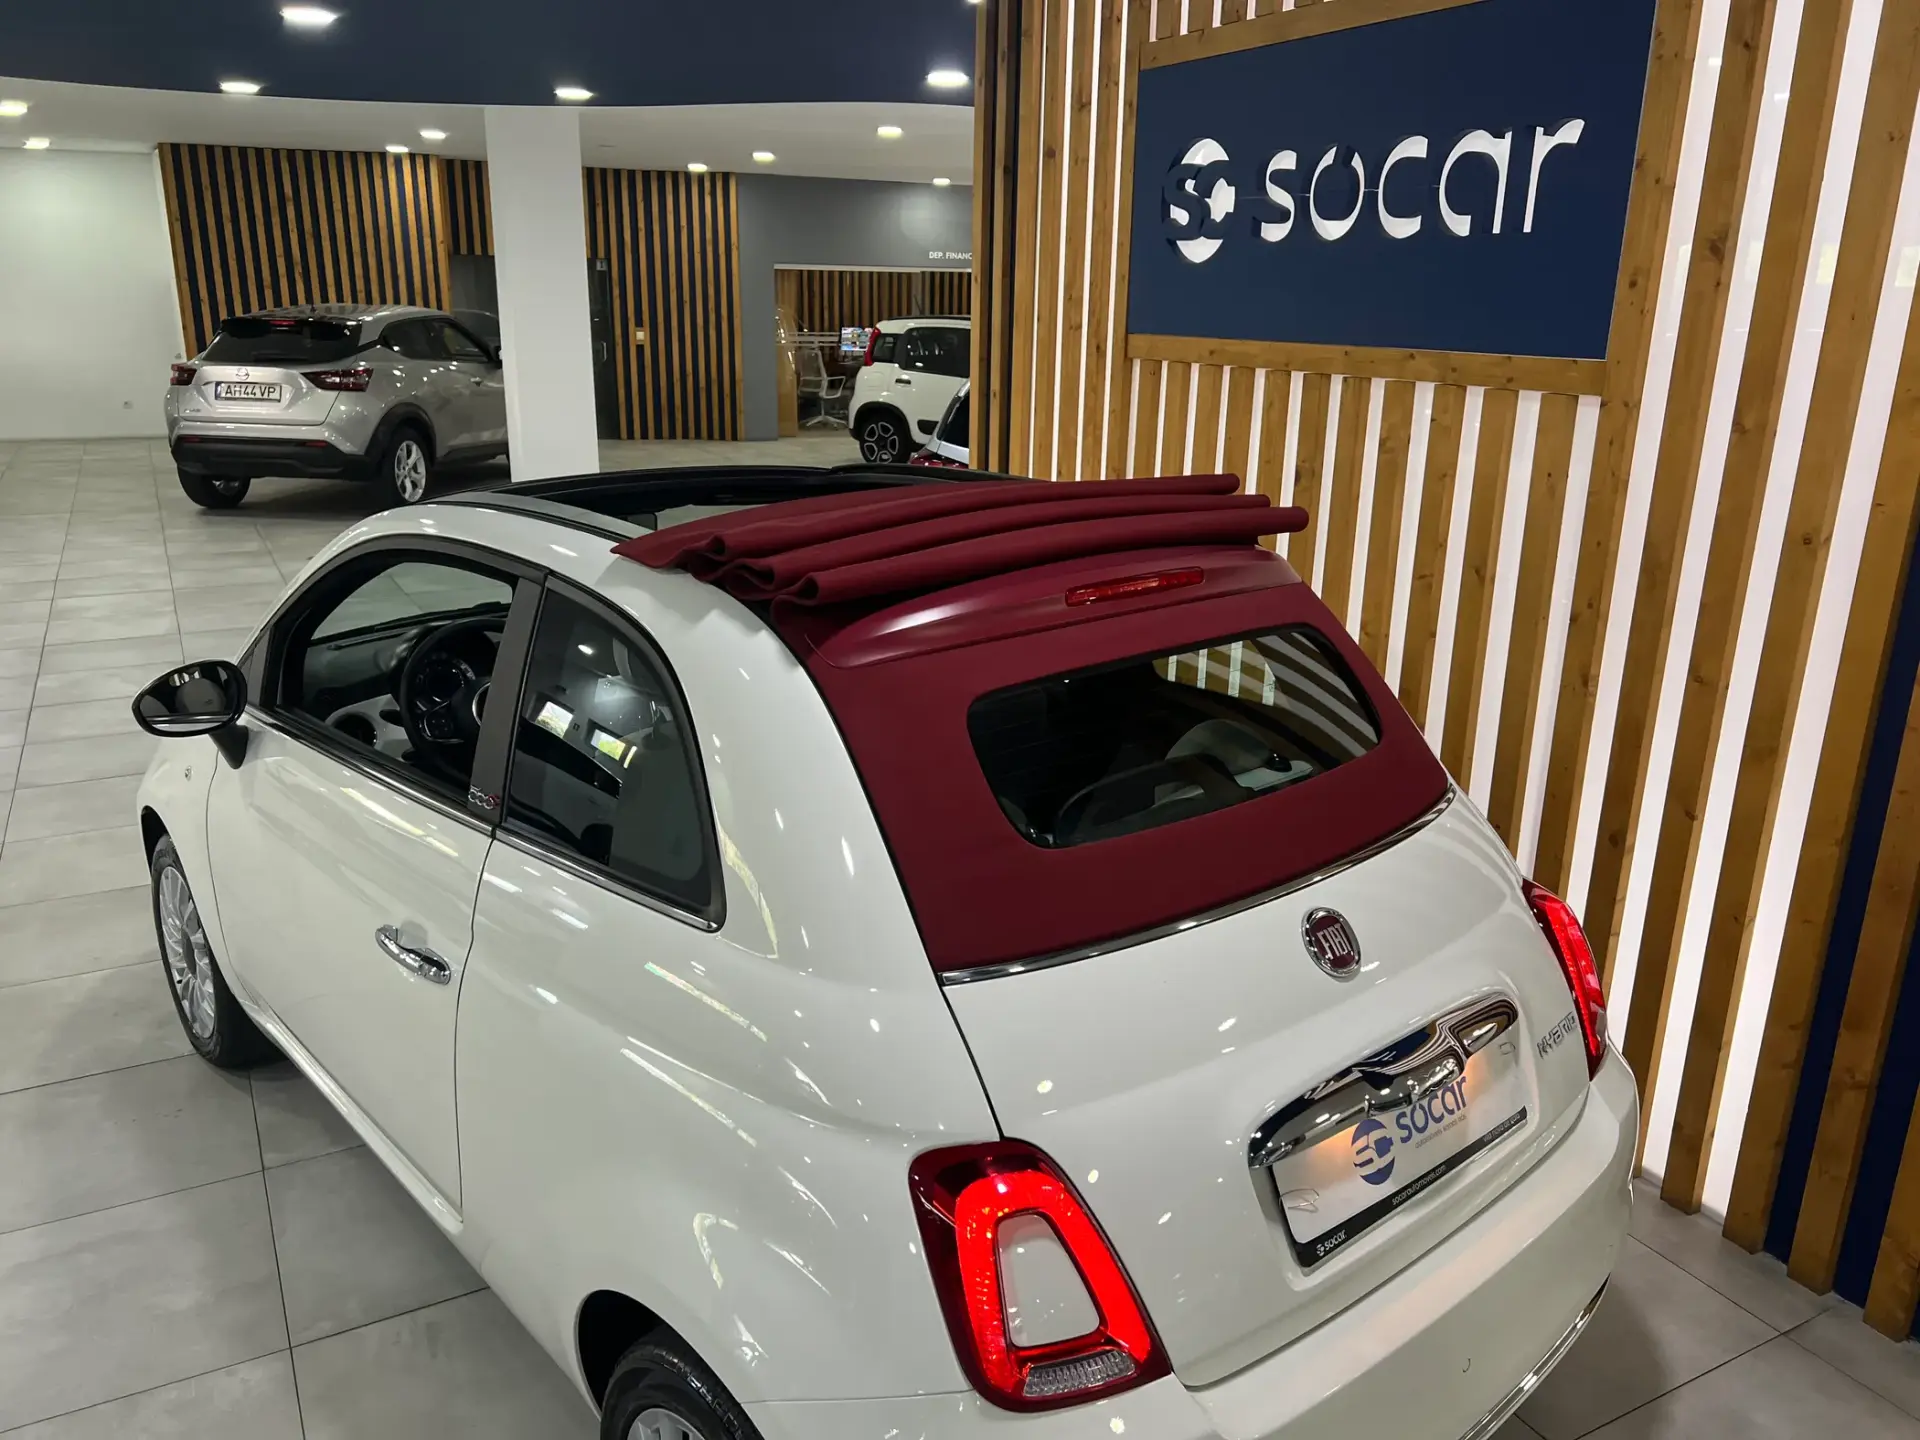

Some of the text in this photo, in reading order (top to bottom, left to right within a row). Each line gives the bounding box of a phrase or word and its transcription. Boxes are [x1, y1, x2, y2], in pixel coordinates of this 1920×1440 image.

[1256, 118, 1586, 243] socar
[928, 251, 945, 260] DEP.
[1316, 922, 1354, 960] FIAT
[1536, 1011, 1577, 1060] HYBRID
[1395, 1075, 1467, 1144] socar
